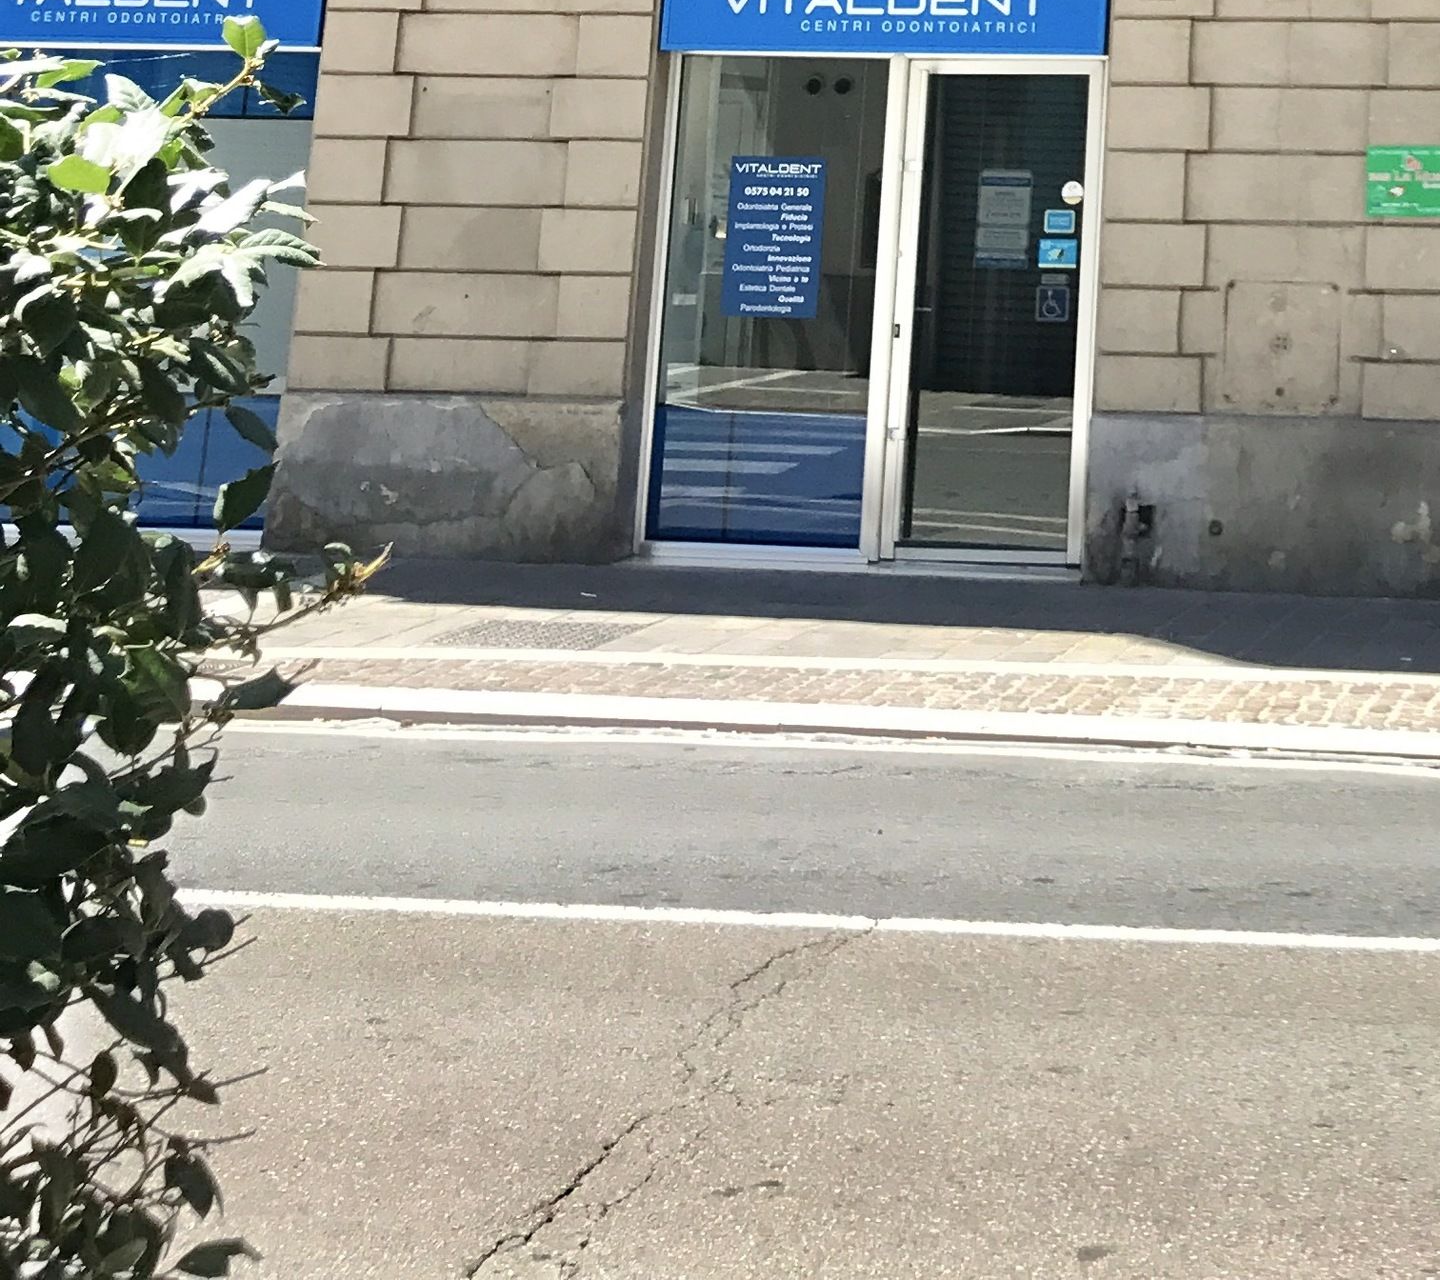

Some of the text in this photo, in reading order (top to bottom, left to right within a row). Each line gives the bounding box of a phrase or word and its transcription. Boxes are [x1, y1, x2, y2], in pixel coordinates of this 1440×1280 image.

[30, 11, 243, 27] CENTRI ODONTOIATR
[800, 19, 1037, 34] CENTRI ODONTOIATRICI
[735, 163, 822, 174] VITALDENT
[744, 186, 809, 197] 0575 04 21 50
[772, 233, 812, 244] Tecnologia
[767, 254, 812, 262] Innovazione
